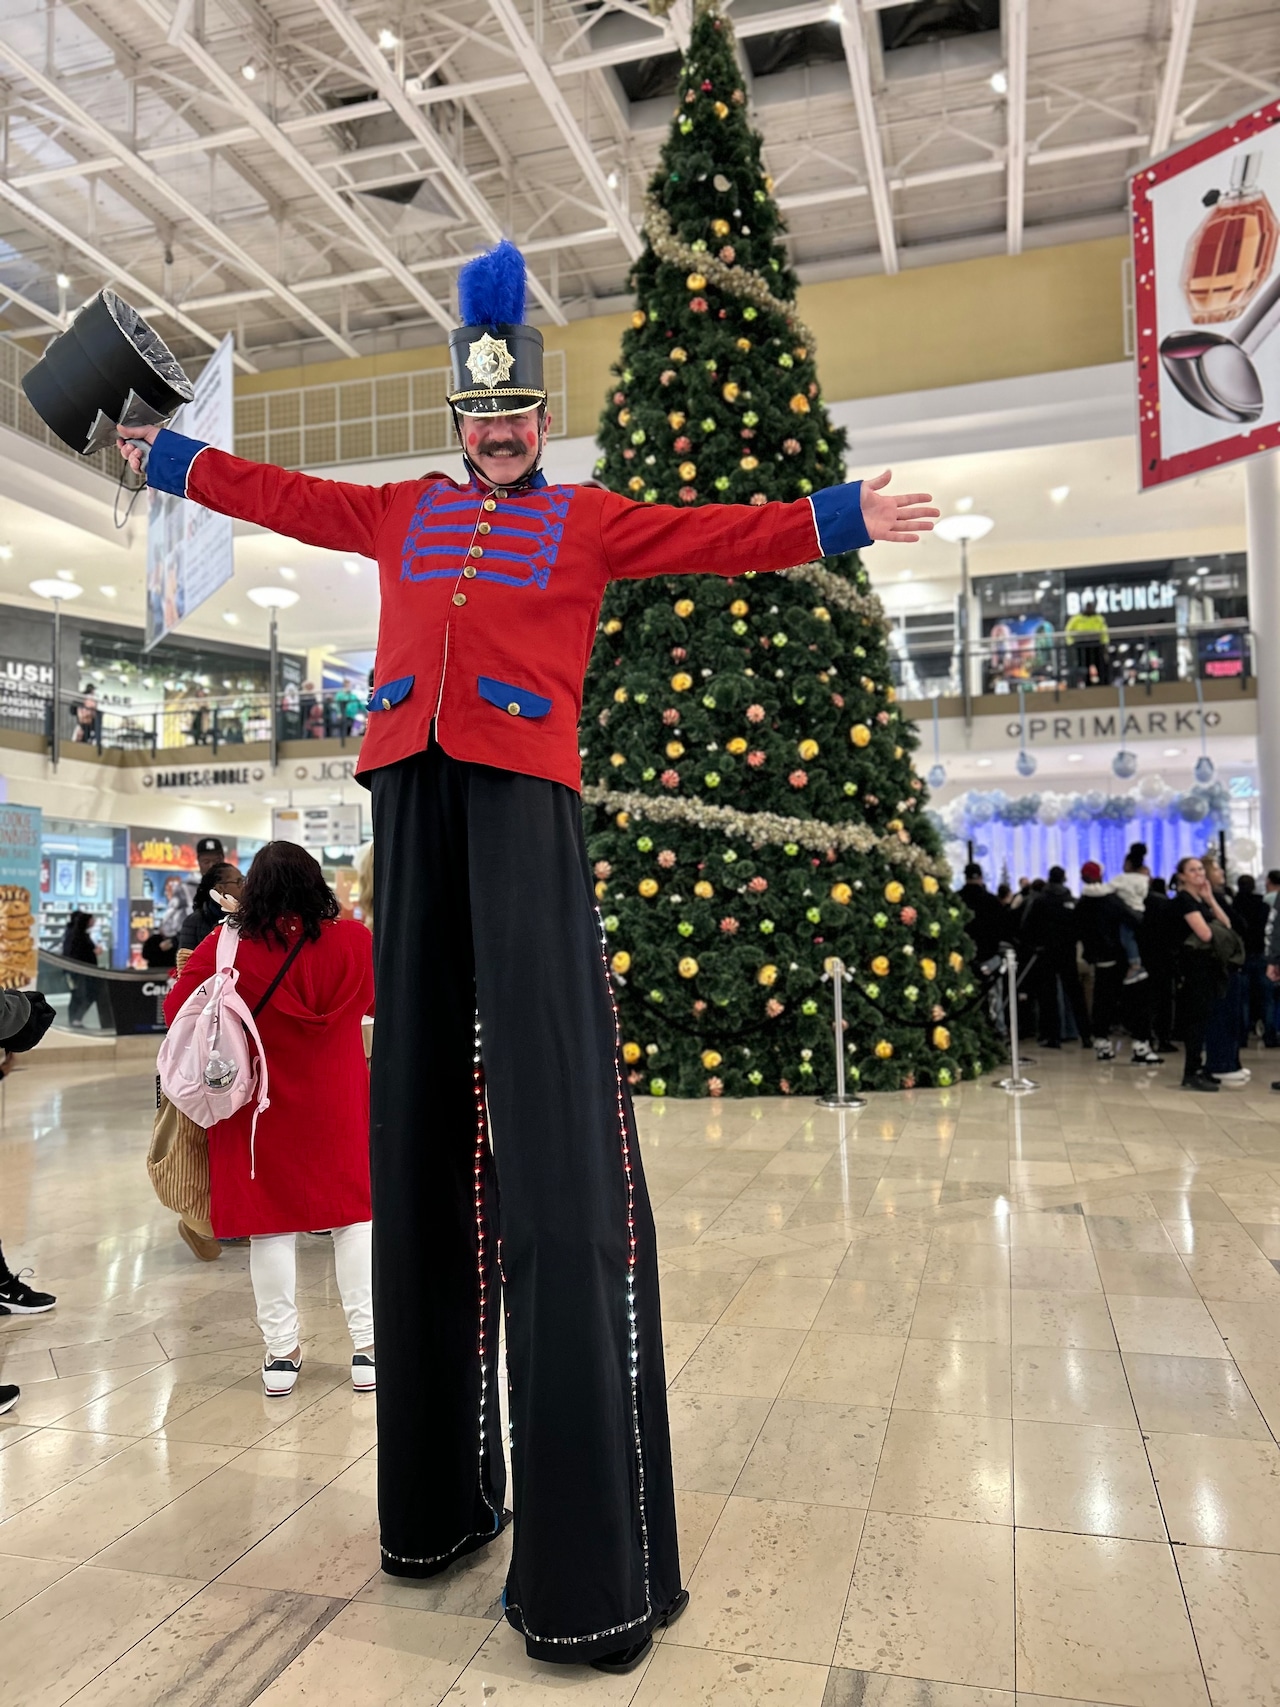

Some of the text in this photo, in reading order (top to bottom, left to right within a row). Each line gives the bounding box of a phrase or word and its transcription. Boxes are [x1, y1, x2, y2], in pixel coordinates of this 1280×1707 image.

[0, 661, 54, 684] USH
[1029, 711, 1196, 740] PRIMARK
[312, 761, 355, 781] J.CR
